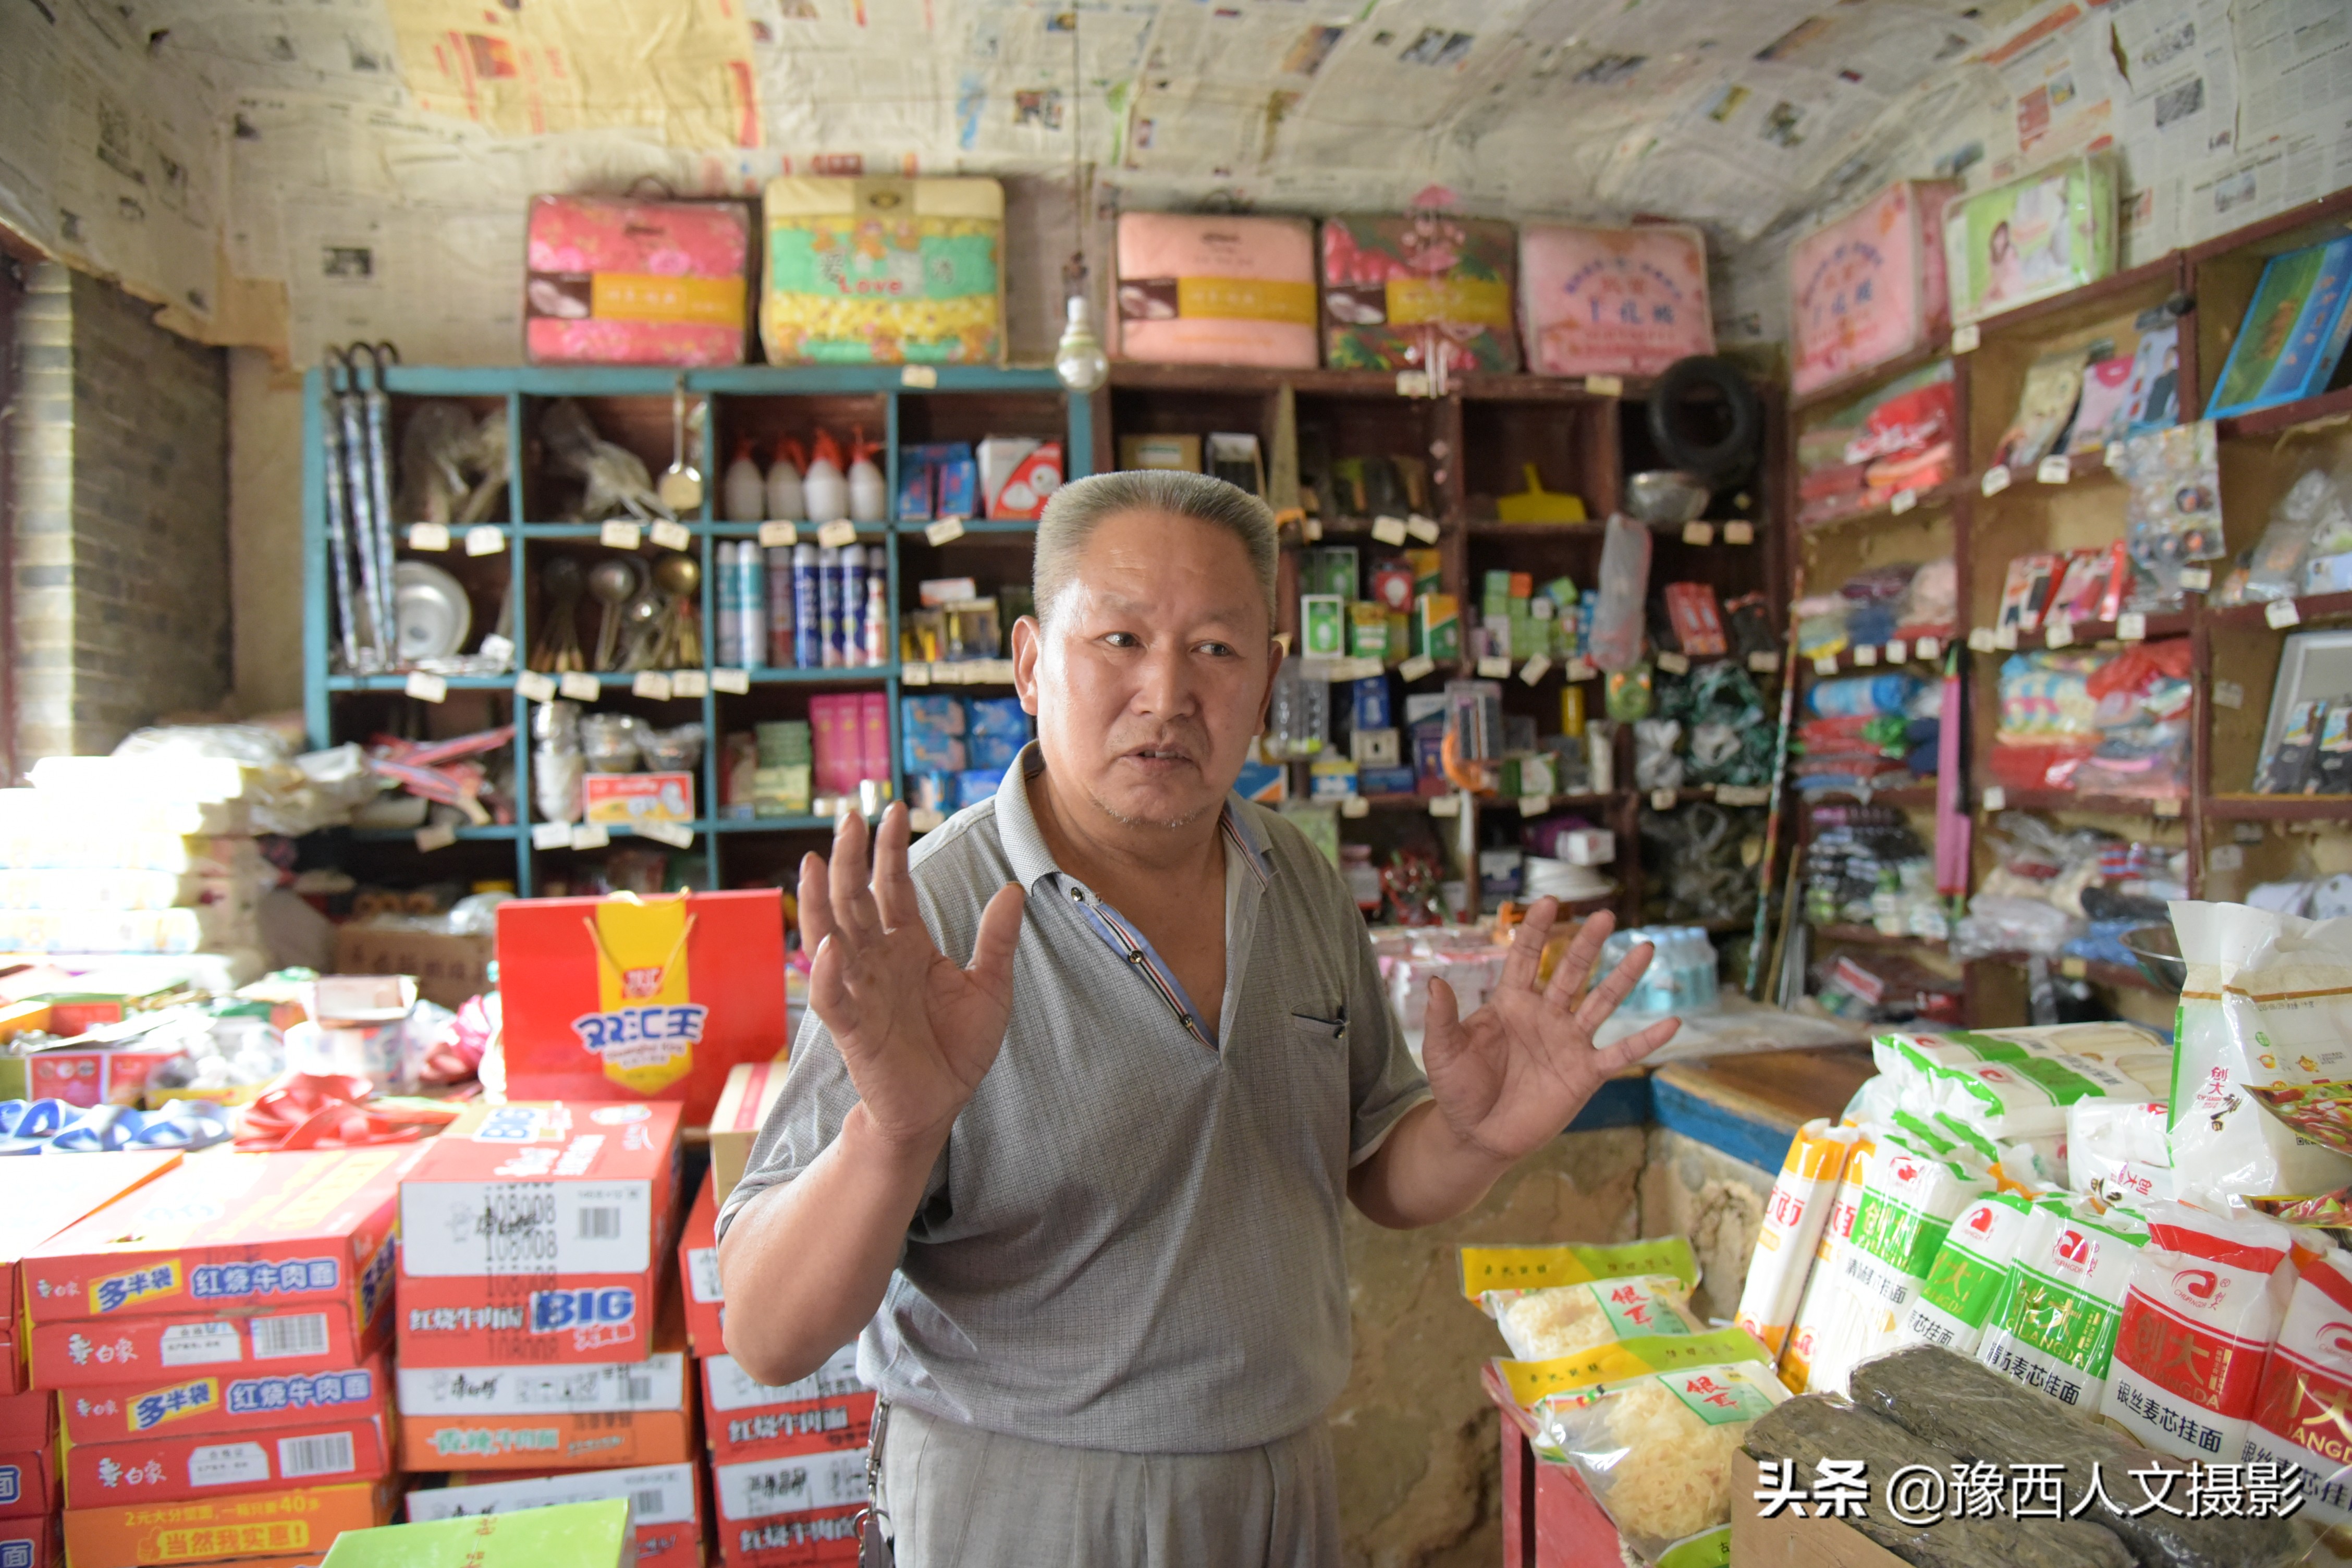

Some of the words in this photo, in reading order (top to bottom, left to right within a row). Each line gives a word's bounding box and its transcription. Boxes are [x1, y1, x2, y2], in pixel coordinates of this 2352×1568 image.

[838, 275, 903, 295] Love
[2207, 1066, 2230, 1096] 创大
[96, 1264, 173, 1313] 多半袋
[193, 1260, 336, 1297] 红烧牛肉面
[532, 1289, 635, 1334] BIG
[2135, 1310, 2210, 1387] 创大
[136, 1382, 212, 1429] 多半袋
[229, 1373, 370, 1411] 红烧牛肉面
[1686, 1376, 1740, 1410] 银耳
[2116, 1379, 2223, 1453] 银丝麦芯挂面
